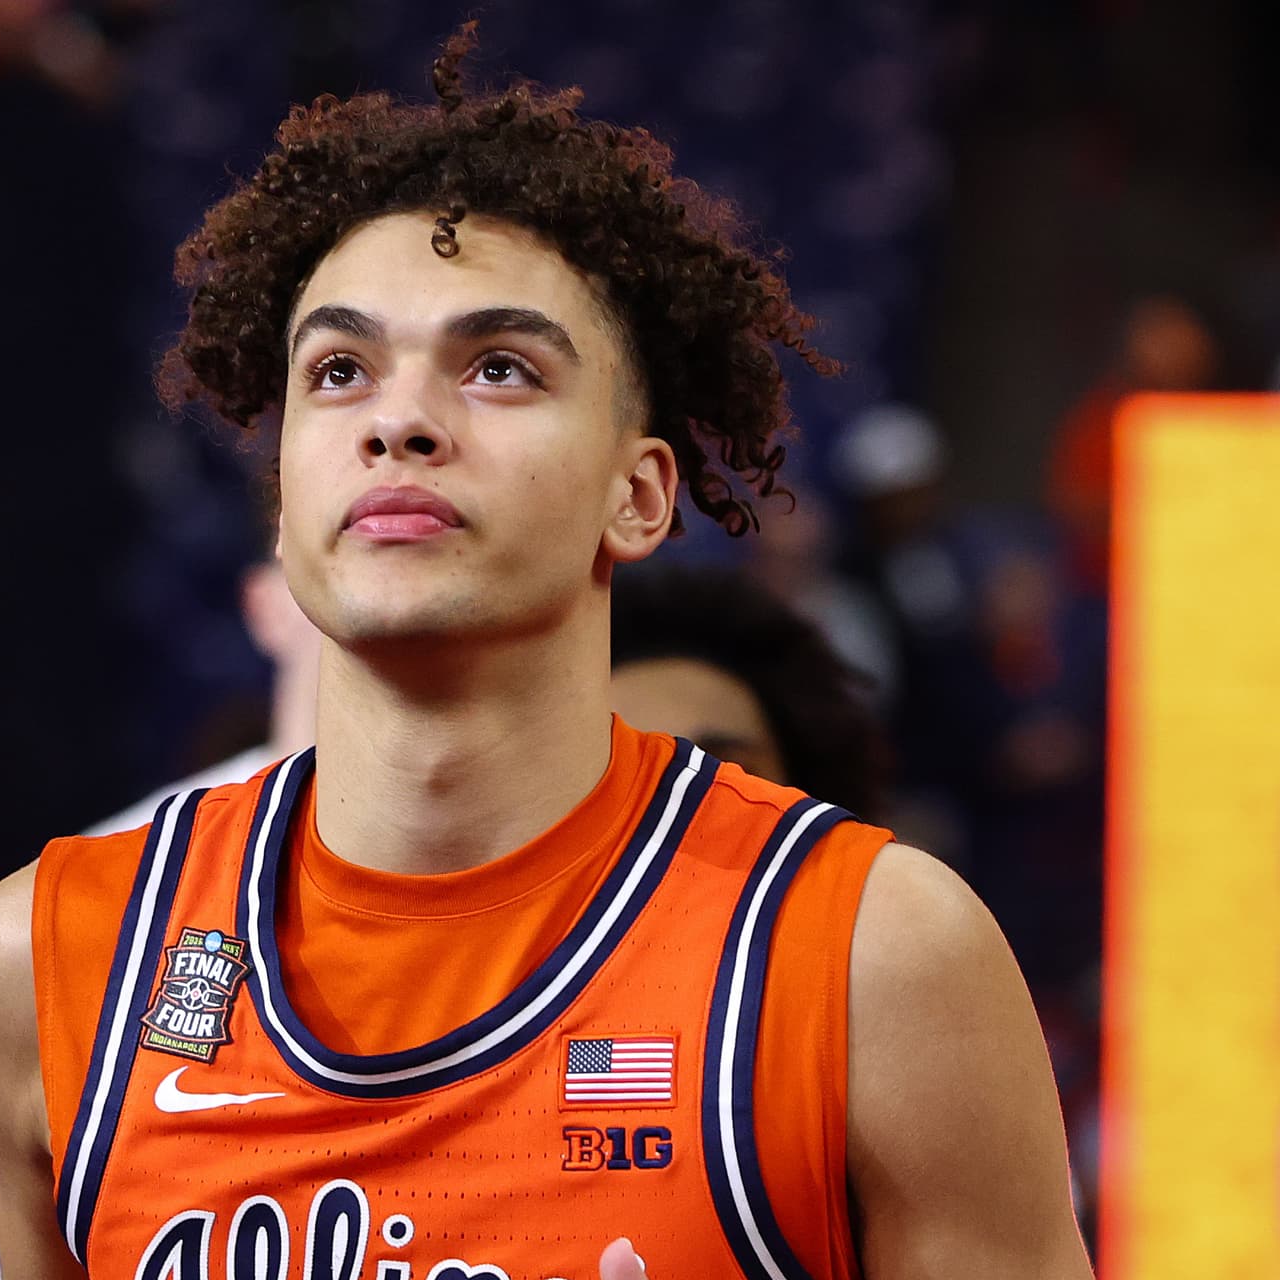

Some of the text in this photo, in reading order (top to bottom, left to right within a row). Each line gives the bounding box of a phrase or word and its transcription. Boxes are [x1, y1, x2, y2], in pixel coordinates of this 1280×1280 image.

[222, 943, 240, 957] MEN'S
[174, 952, 234, 986] FINAL
[155, 1003, 215, 1037] FOUR
[149, 1032, 209, 1055] INDIANAPOLIS
